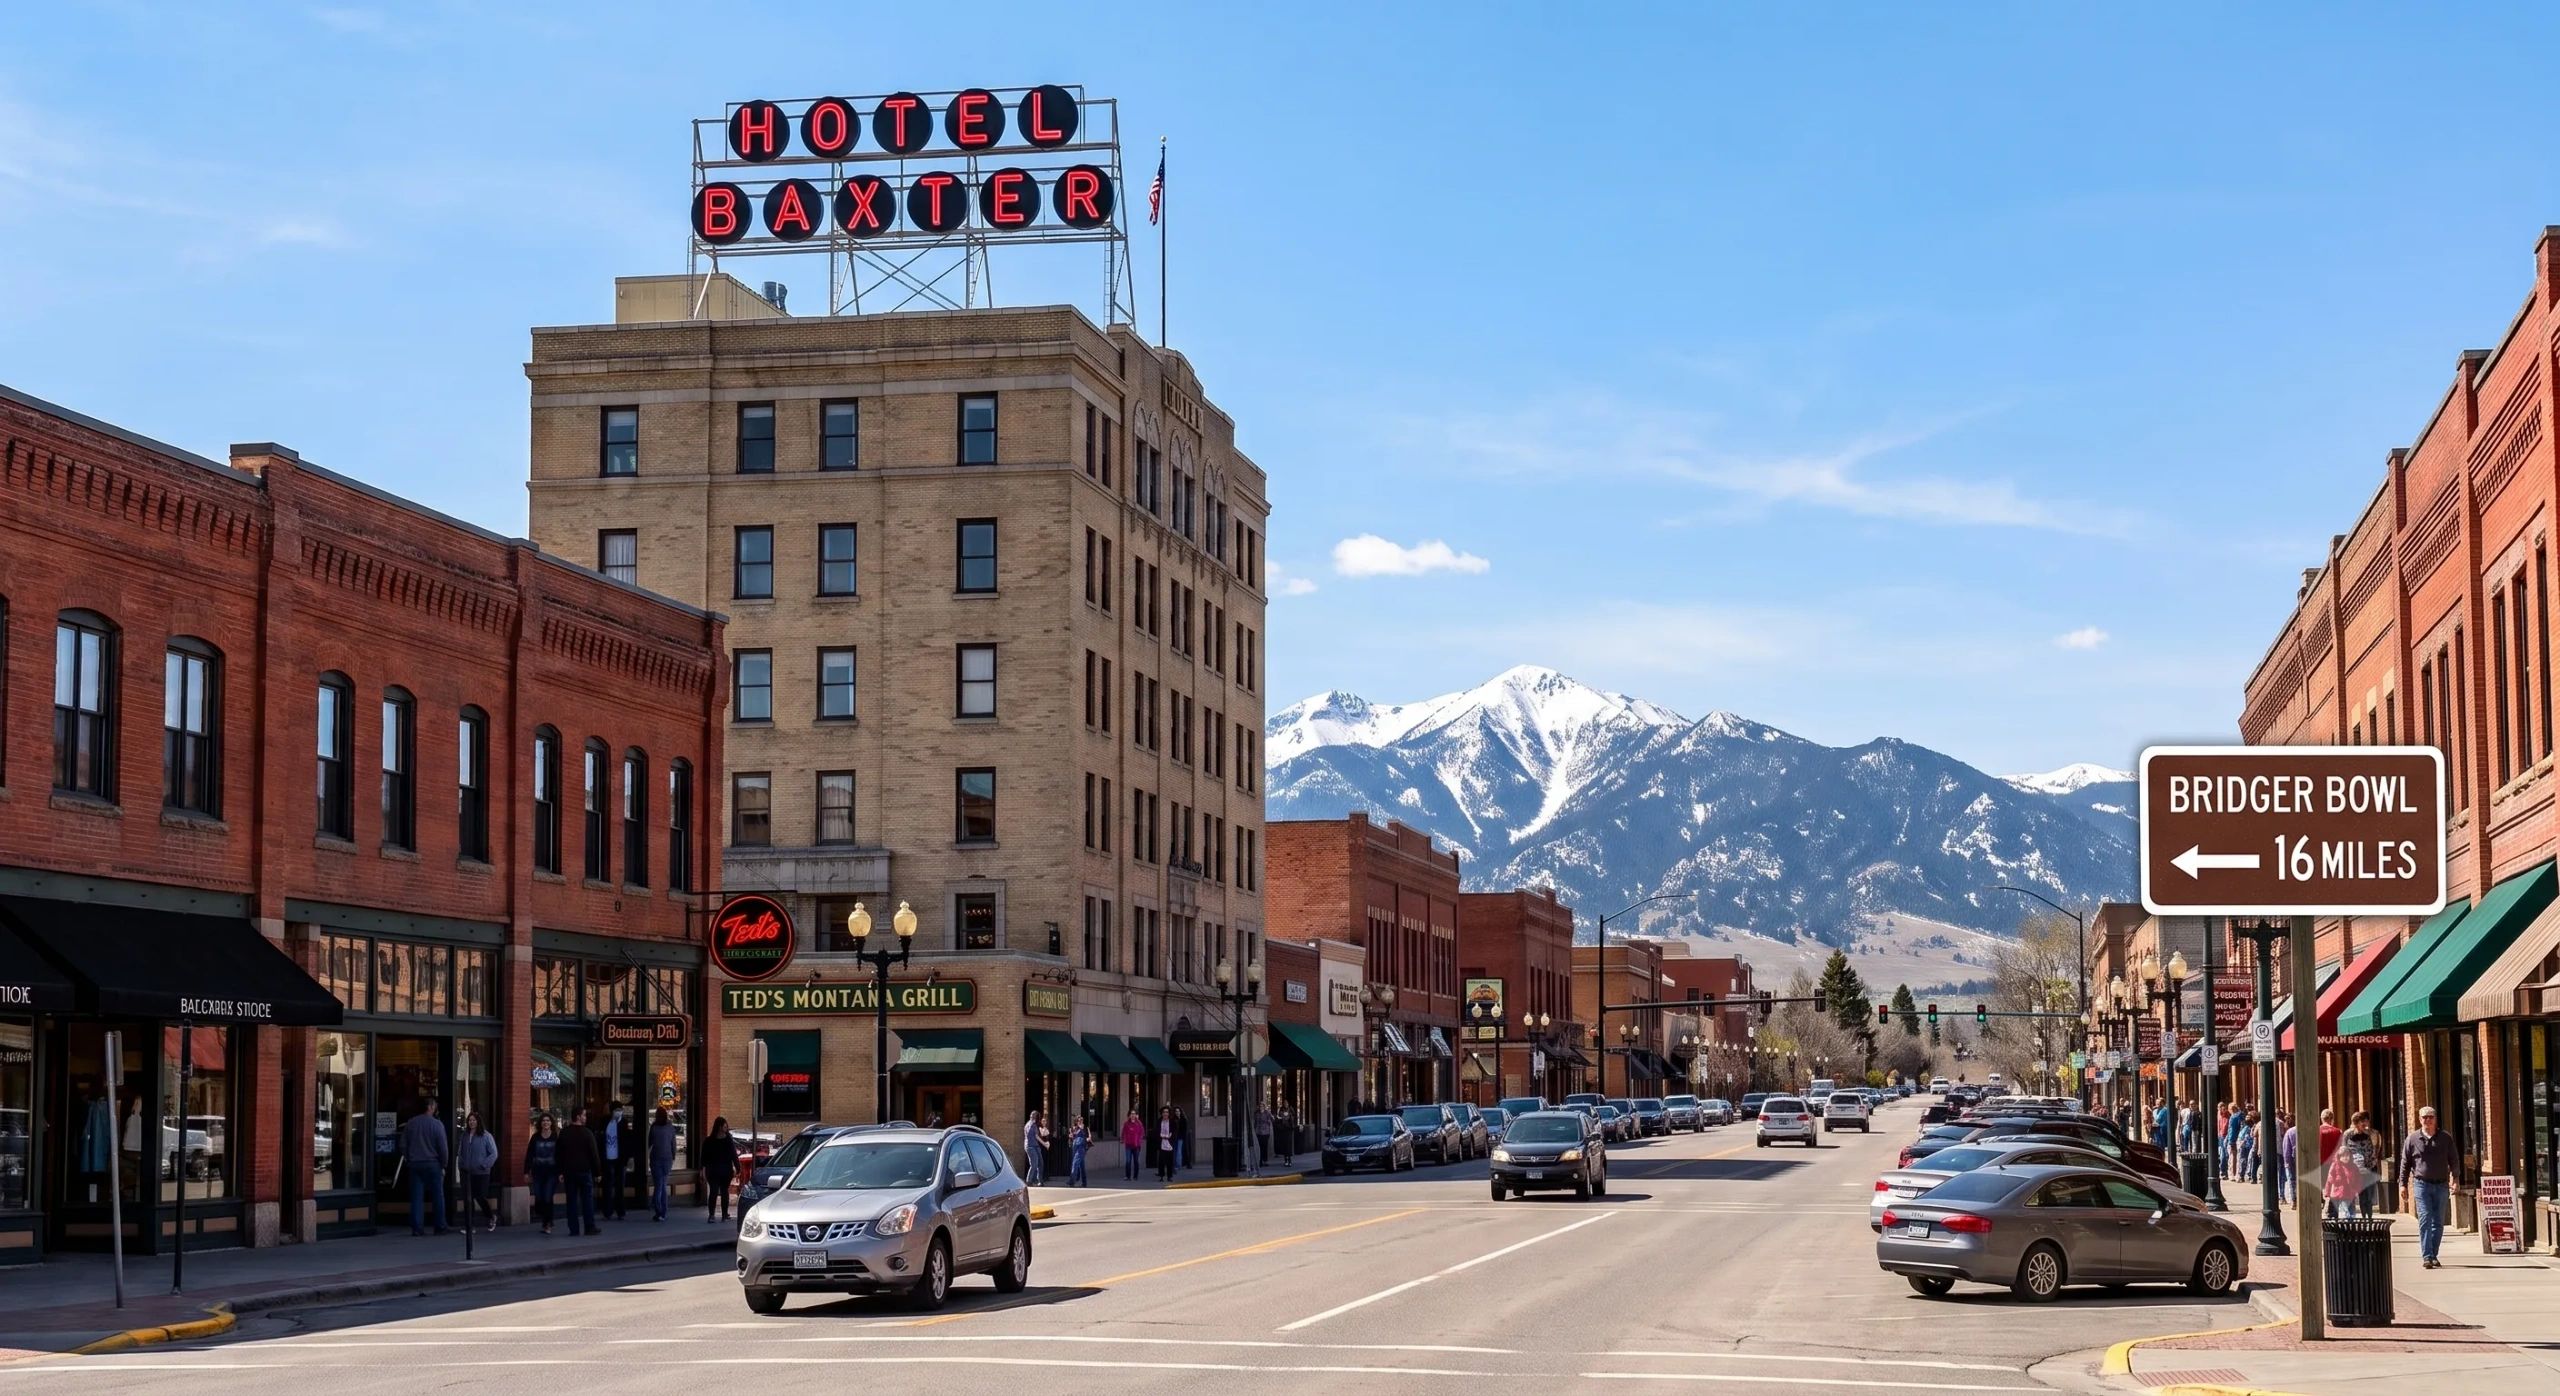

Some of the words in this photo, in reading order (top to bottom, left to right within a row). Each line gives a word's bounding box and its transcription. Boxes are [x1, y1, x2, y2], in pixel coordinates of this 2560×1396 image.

[741, 92, 1062, 154] HOTEL
[704, 170, 1101, 236] BAXTER
[2169, 775, 2314, 813] BRIDGER
[2326, 775, 2418, 813] BOWL
[2274, 834, 2314, 881] 16
[2321, 840, 2417, 879] MILES
[721, 911, 781, 946] Ted's
[729, 990, 785, 1009] TED'S
[793, 988, 895, 1009] MONTANA
[902, 988, 962, 1007] GRILL
